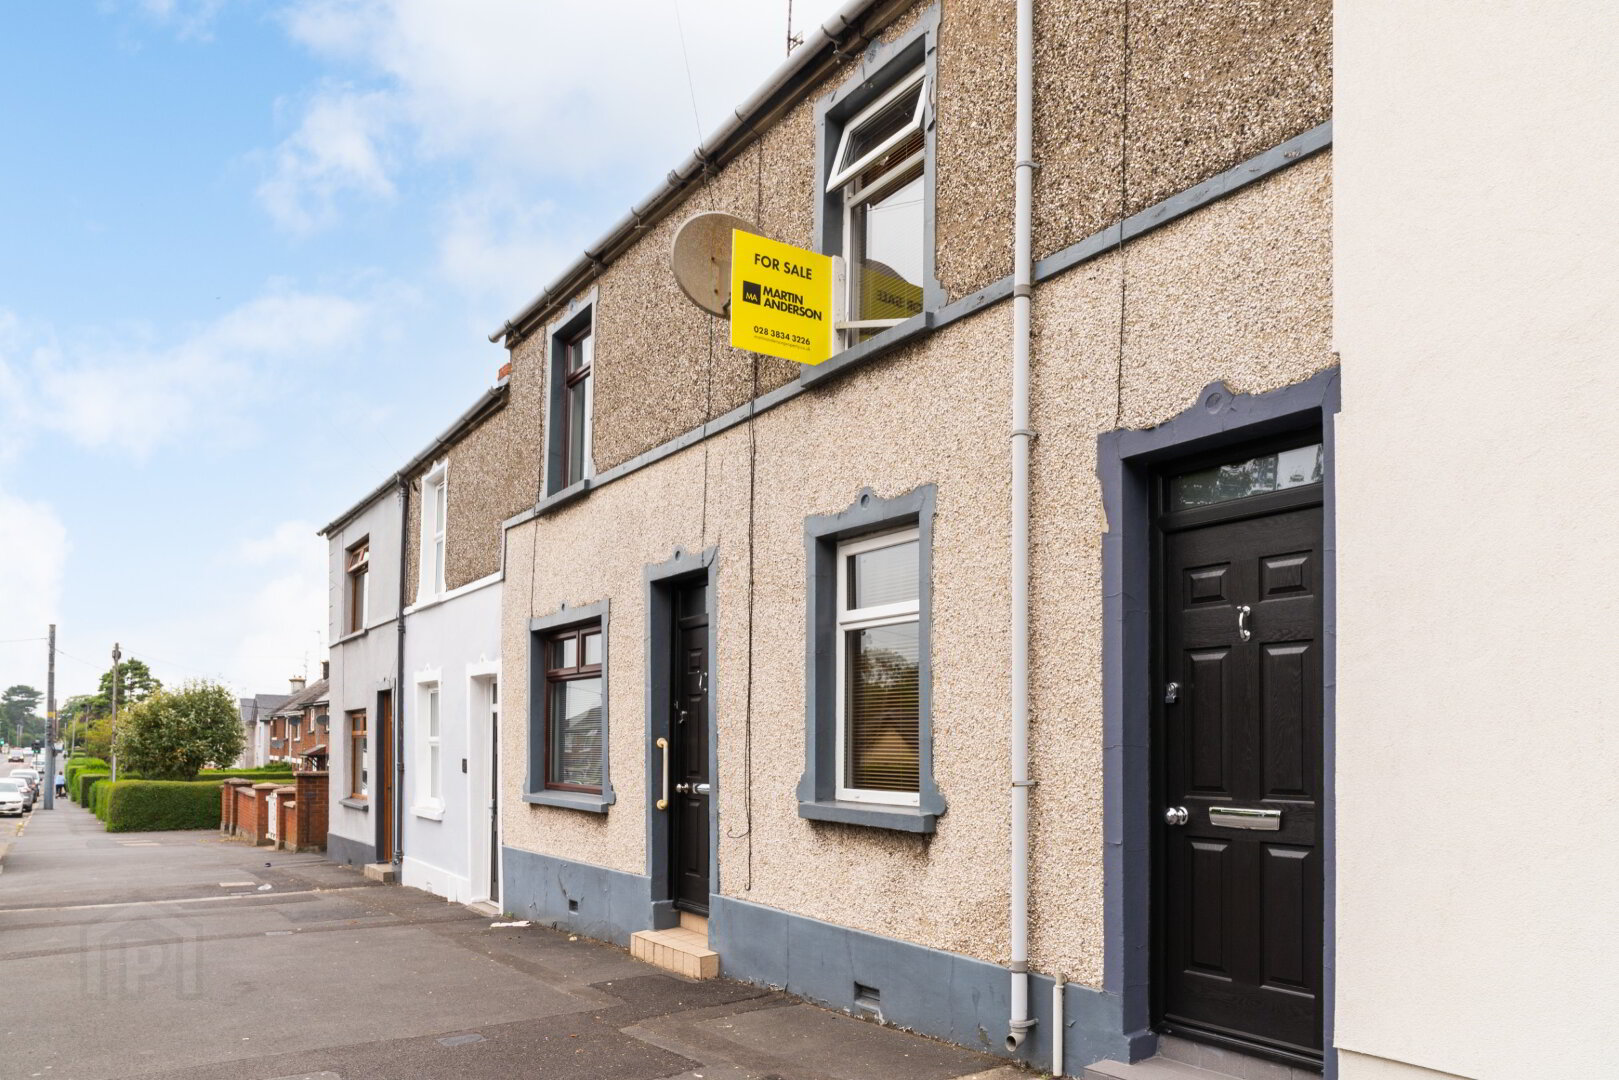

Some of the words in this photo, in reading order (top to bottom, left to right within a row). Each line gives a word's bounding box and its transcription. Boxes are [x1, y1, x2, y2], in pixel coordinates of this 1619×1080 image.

[754, 253, 780, 271] FOR
[783, 262, 812, 280] SALE
[745, 292, 758, 301] MA
[763, 286, 804, 305] MARTIN
[764, 298, 822, 321] ANDERSON
[753, 325, 769, 336] 028
[770, 329, 790, 341] 3834
[791, 334, 811, 346] 3226
